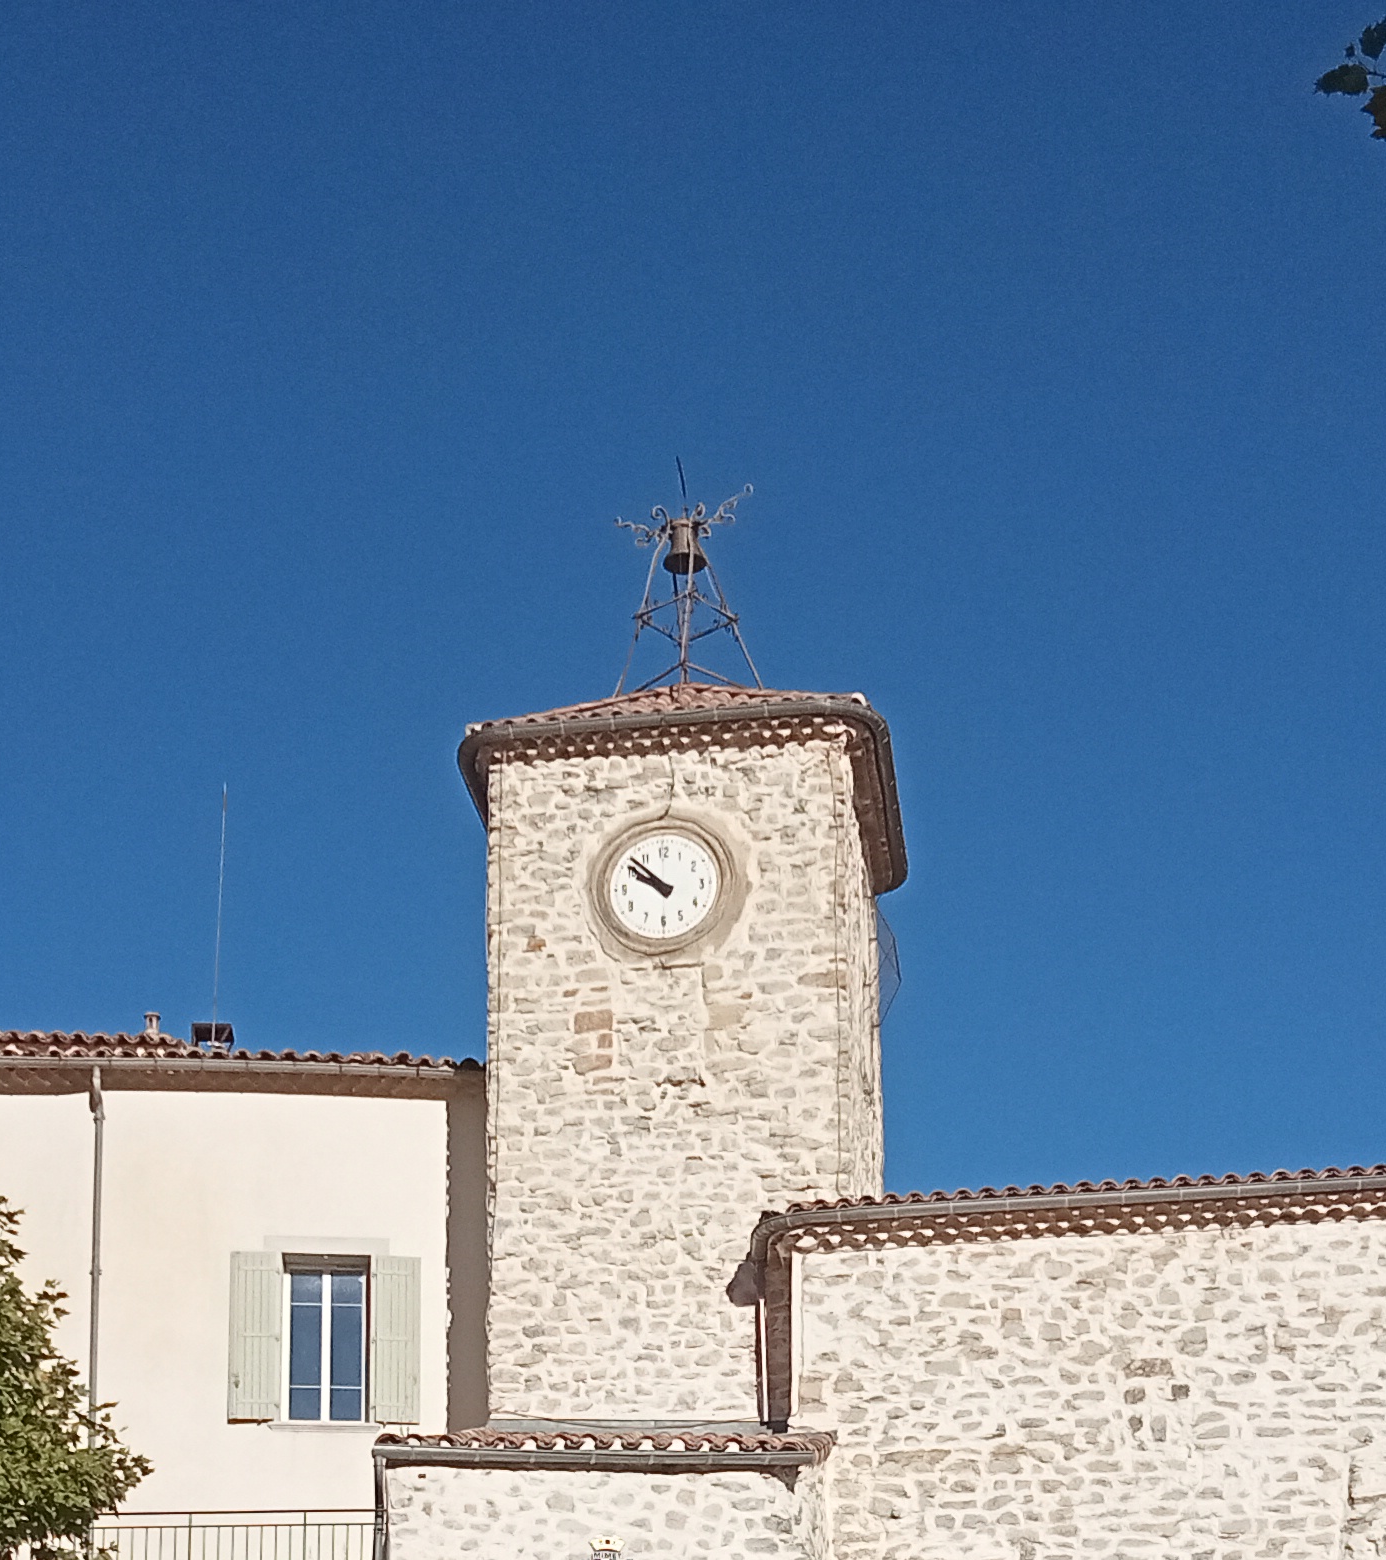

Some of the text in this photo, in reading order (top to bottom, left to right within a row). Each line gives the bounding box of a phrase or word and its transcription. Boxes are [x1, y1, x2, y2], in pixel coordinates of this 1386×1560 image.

[658, 847, 669, 858] 12
[642, 854, 649, 864] 11
[691, 861, 696, 872] 2
[621, 884, 627, 895] 9
[700, 879, 705, 889] 3
[628, 901, 633, 912] 8
[693, 898, 698, 908] 4
[644, 912, 649, 923] 7
[661, 915, 666, 927] 6
[678, 910, 683, 921] 5
